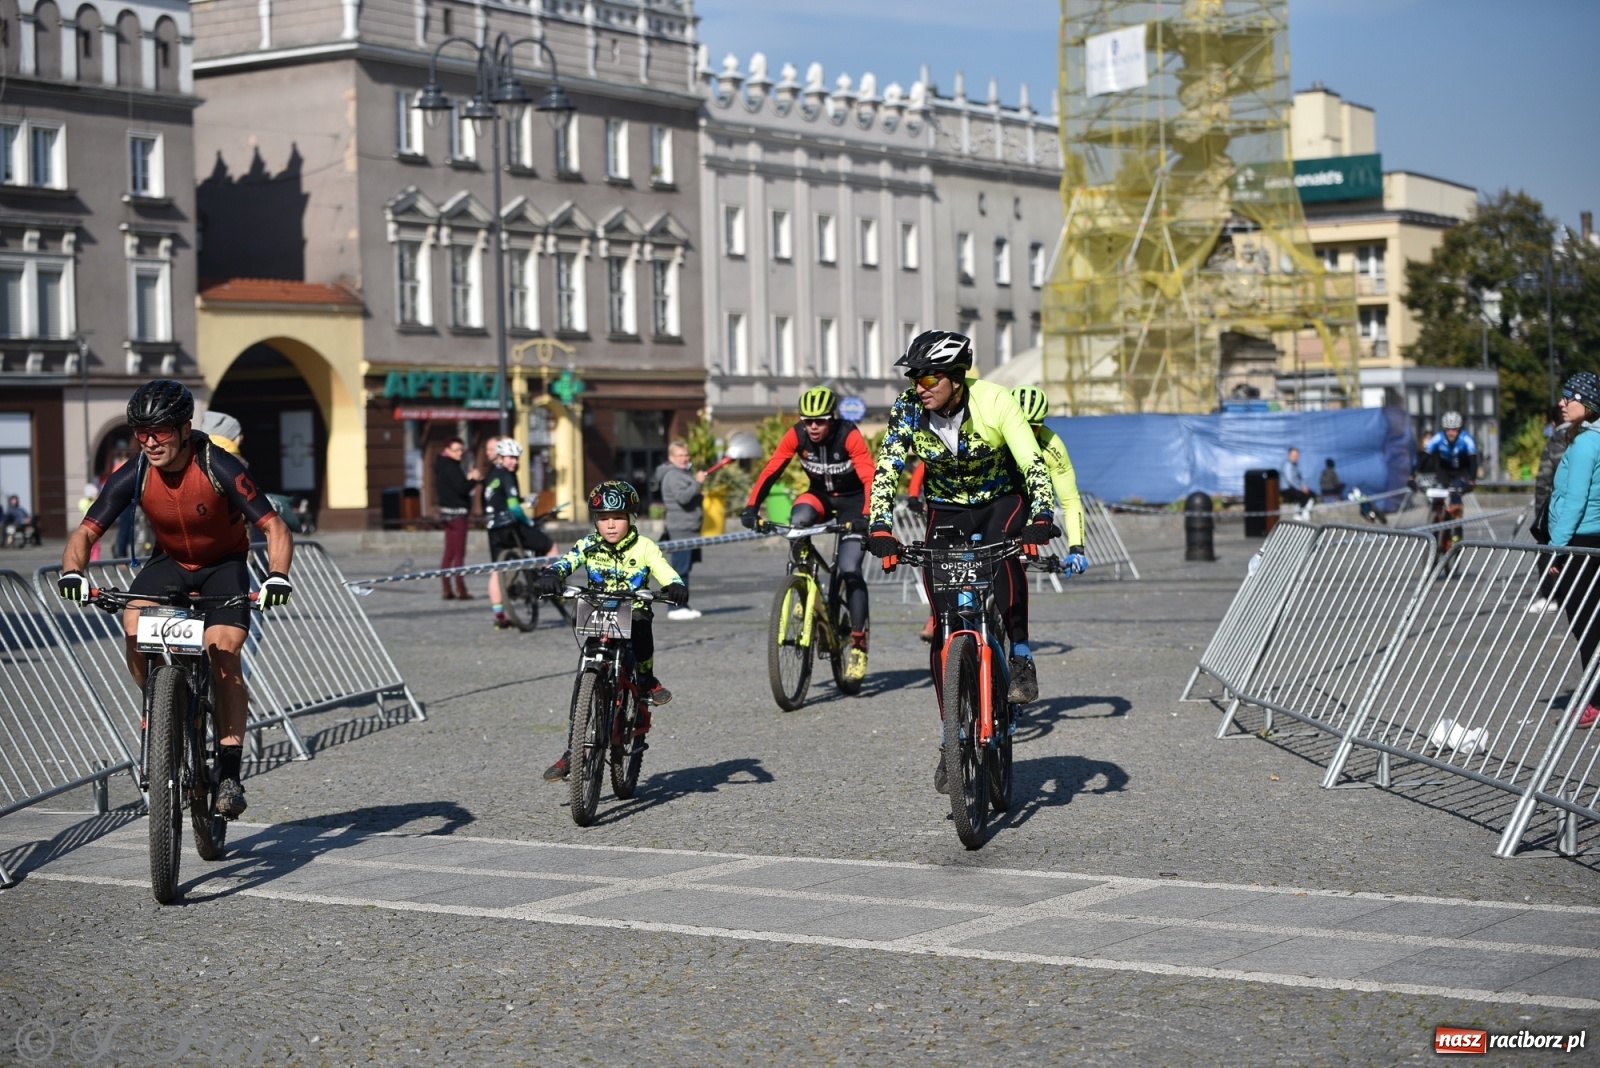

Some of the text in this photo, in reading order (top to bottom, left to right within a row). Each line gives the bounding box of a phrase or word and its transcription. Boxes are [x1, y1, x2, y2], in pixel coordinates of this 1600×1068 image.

[941, 560, 983, 570] OPIEKUN
[948, 569, 977, 583] 175
[150, 622, 194, 639] 1006
